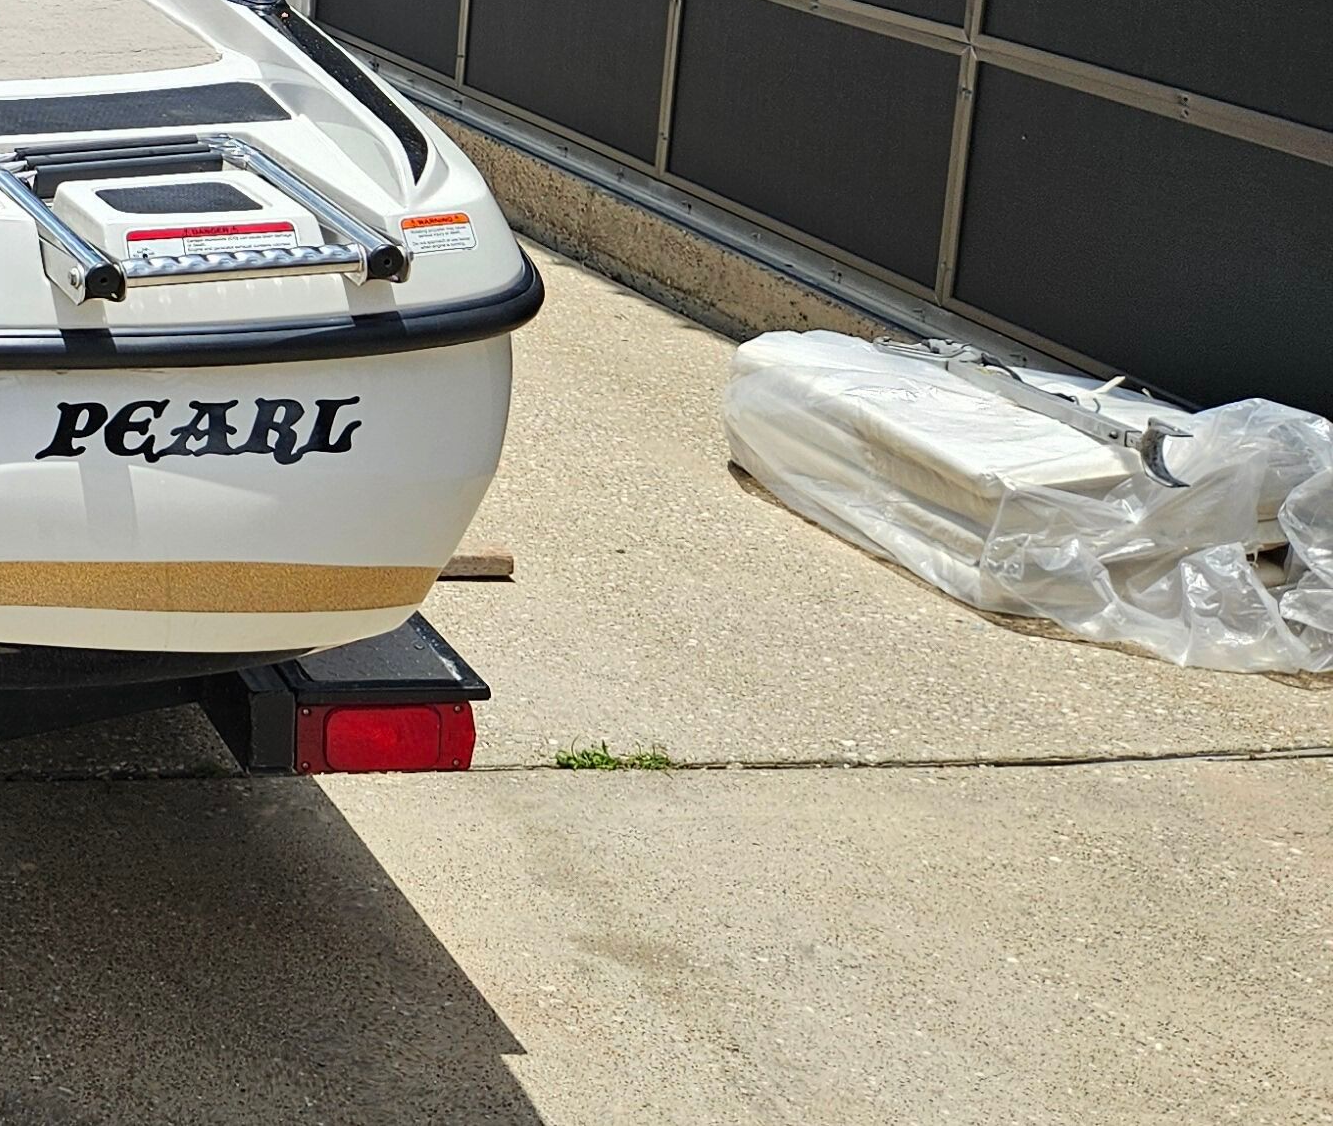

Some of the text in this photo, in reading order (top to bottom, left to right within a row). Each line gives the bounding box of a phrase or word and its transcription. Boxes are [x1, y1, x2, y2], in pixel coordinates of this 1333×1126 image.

[417, 217, 454, 226] WARNING
[191, 226, 231, 236] DANGER
[34, 395, 363, 466] PEARL
